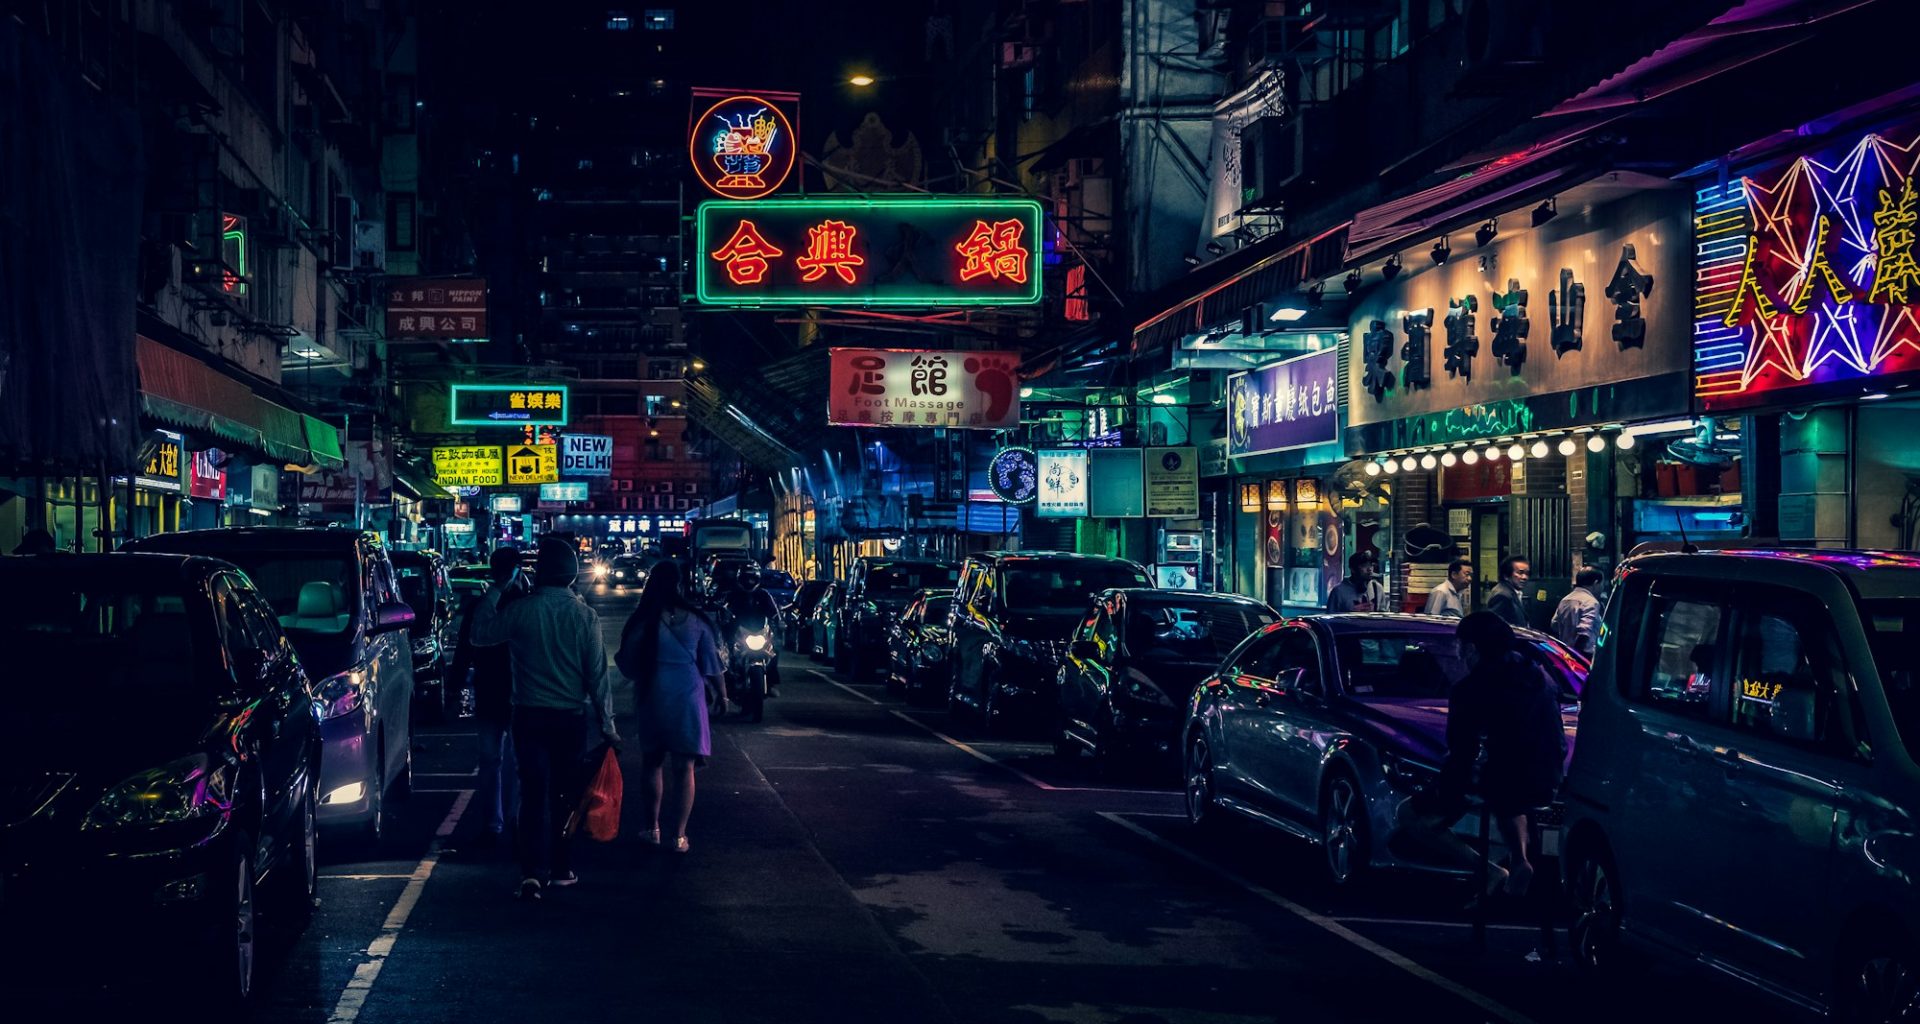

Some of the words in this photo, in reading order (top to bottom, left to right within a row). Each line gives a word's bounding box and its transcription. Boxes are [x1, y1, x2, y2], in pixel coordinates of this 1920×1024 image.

[391, 290, 424, 302] 立邦
[448, 289, 482, 297] NIPPON
[398, 315, 477, 332] 成興公司
[855, 397, 890, 408] Foot
[895, 397, 964, 410] Massage
[570, 438, 606, 452] NEW
[565, 454, 611, 469] DELHI
[439, 476, 468, 485] INDIAN
[473, 475, 497, 484] FOOD
